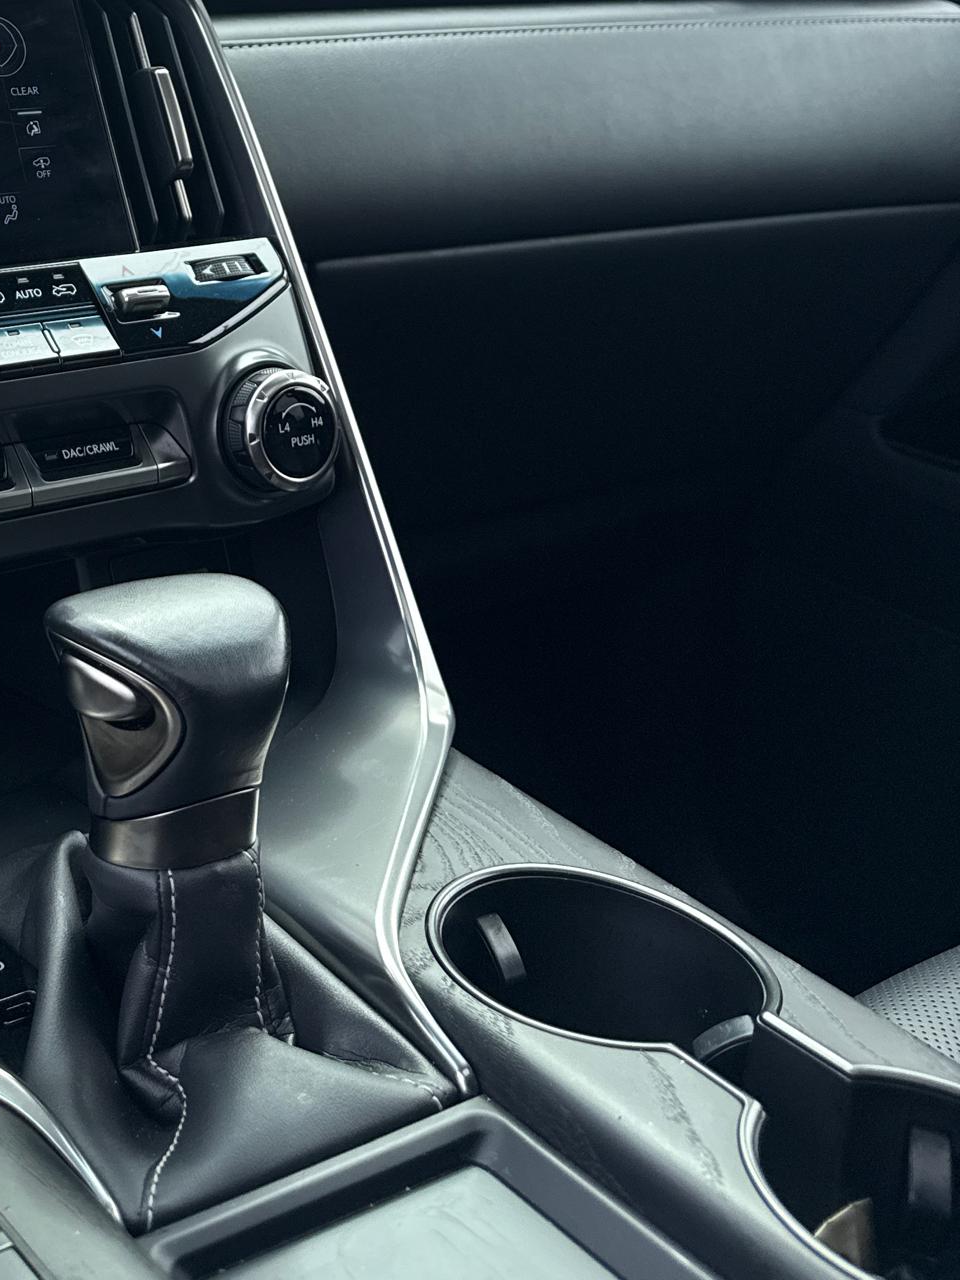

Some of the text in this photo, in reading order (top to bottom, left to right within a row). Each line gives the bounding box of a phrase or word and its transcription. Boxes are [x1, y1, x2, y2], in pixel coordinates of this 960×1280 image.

[10, 86, 40, 97] CLEAR
[36, 170, 52, 178] OFF
[15, 288, 43, 300] AUTO
[278, 422, 291, 434] L4
[310, 416, 324, 428] H4
[290, 433, 315, 448] PUSH
[61, 440, 120, 460] DAC/CRAWL
